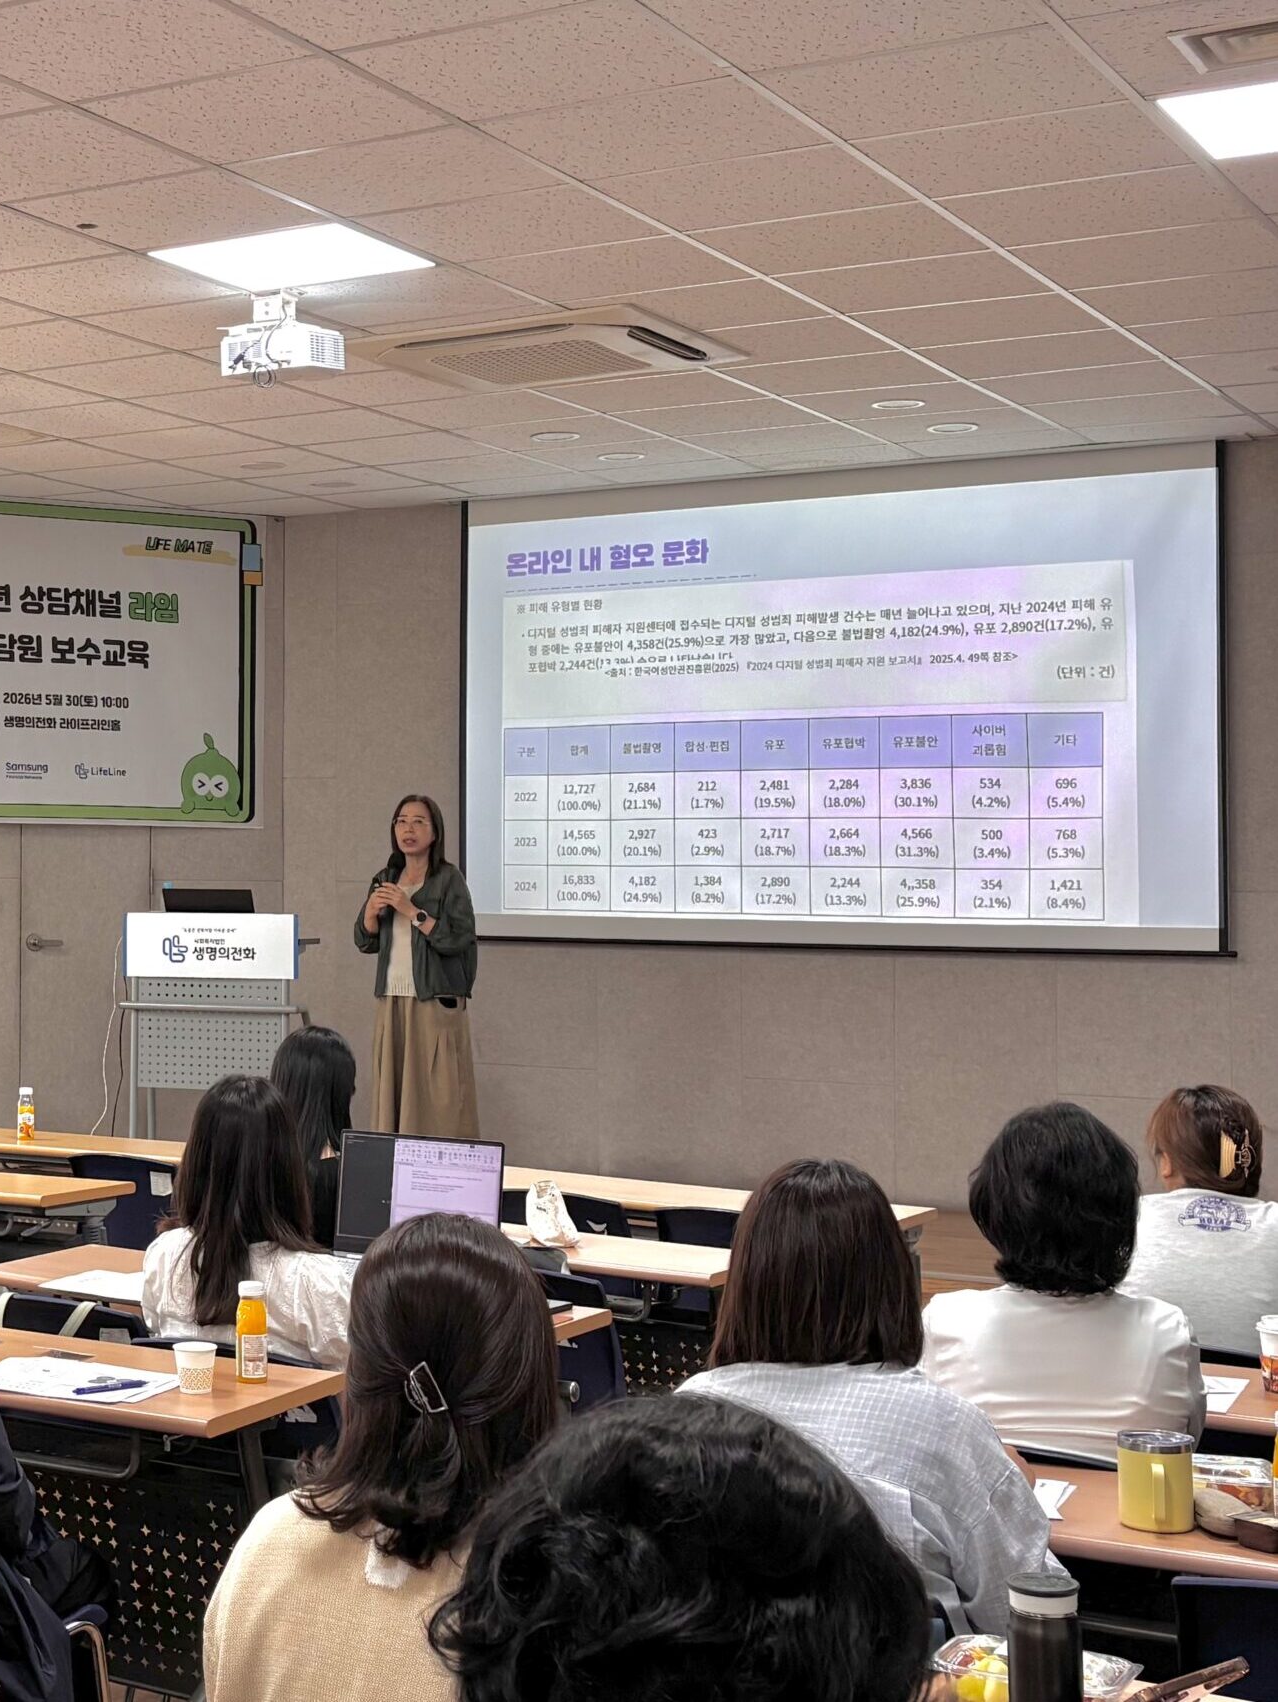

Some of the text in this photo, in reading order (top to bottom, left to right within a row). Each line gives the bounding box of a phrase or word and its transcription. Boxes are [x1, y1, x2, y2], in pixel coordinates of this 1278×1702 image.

[174, 539, 213, 554] MATE
[506, 538, 709, 577] 온라인 내 혐오 문화
[19, 586, 121, 618] 상담채널
[128, 592, 179, 623] 라임
[529, 603, 547, 613] 피해
[551, 601, 580, 612] 유형별
[584, 599, 602, 610] 현황
[528, 598, 1112, 638] 디지털 성범죄 피해자 지원센터에 접수되는 디지털 성범죄 피해발생 건수는 매년 늘어나고 있으며, 지난 2024년 피해 유
[542, 644, 569, 655] 중에는
[574, 641, 623, 653] 유포불안이
[627, 636, 724, 651] 4,358건(25.9%)으로
[730, 634, 749, 646] 가장
[755, 632, 789, 644] 많았고,
[794, 630, 837, 642] 다음으로
[842, 627, 885, 641] 불법촬영
[890, 623, 968, 638] 4,182(24.9%),
[974, 623, 996, 635] 유포
[1001, 617, 1096, 634] 2,890건(17.2%),
[1101, 617, 1113, 630] 유
[51, 636, 149, 668] 보수교육
[776, 660, 802, 670] 디지털
[806, 658, 832, 669] 성범죄
[836, 657, 863, 667] 피해자
[867, 656, 884, 666] 지원
[930, 654, 965, 664] 2025.4.
[968, 652, 989, 662] 49쪽
[528, 662, 556, 673] 포협박
[1057, 665, 1086, 679] (단위
[3, 693, 42, 705] 2026년
[45, 694, 62, 706] 5월
[66, 695, 97, 707] 30(토)
[102, 696, 129, 708] 10:00
[4, 716, 56, 729] 생명의전화
[60, 718, 121, 731] 라이프라인홀
[972, 725, 1006, 736] 사이버
[764, 739, 785, 750] 유포
[823, 737, 866, 749] 유포협박
[893, 736, 938, 748] 유포불안
[1054, 735, 1076, 746] 기타
[517, 747, 536, 757] 구분
[623, 743, 662, 754] 불법촬영
[6, 762, 48, 773] Samsung
[91, 766, 126, 776] LifeLine
[628, 783, 655, 793] 2,684
[698, 781, 716, 792] 212
[760, 780, 789, 791] 2,481
[829, 779, 859, 790] 2,284
[900, 779, 931, 790] 3,836
[979, 778, 1001, 788] 534
[1055, 778, 1077, 788] 696
[563, 784, 595, 795] 12,727
[514, 793, 537, 802] 2022
[755, 796, 795, 809] (19.5%)
[824, 796, 865, 808] (18.0%)
[895, 795, 937, 808] (30.1%)
[972, 795, 1010, 809] (4.2%)
[1047, 795, 1085, 808] (5.4%)
[558, 800, 601, 812] (100.0%)
[623, 798, 661, 810] (21.1%)
[691, 798, 724, 810] (1.7%)
[563, 830, 595, 841] 14,565
[628, 829, 656, 840] 2,927
[698, 829, 717, 839] 423
[760, 828, 789, 840] 2,717
[829, 829, 859, 840] 2,664
[901, 828, 932, 840] 4,566
[981, 830, 1002, 840] 500
[1056, 830, 1076, 840] 768
[514, 838, 537, 847] 2023
[557, 846, 601, 857] (100.0%)
[623, 846, 661, 858] (20.1%)
[691, 845, 724, 857] (2.9%)
[755, 844, 795, 857] (18.7%)
[824, 844, 866, 857] (18.3%)
[895, 845, 939, 858] (31.3%)
[973, 846, 1011, 859] (3.4%)
[1047, 846, 1085, 859] (5.3%)
[514, 882, 537, 891] 2024
[563, 875, 595, 886] 16,833
[629, 877, 656, 887] 4,182
[694, 876, 722, 887] 1,384
[761, 877, 790, 888] 2,890
[830, 878, 860, 888] 2,244
[981, 880, 1002, 890] 354
[1050, 880, 1082, 891] 1,421
[557, 891, 601, 902] (100.0%)
[623, 892, 662, 904] (24.9%)
[691, 892, 724, 904] (8.2%)
[756, 893, 796, 905] (17.2%)
[825, 894, 866, 907] (13.3%)
[896, 895, 939, 908] (25.9%)
[973, 896, 1011, 908] (2.1%)
[1047, 896, 1086, 909] (8.4%)
[192, 947, 256, 961] 생명의전화
